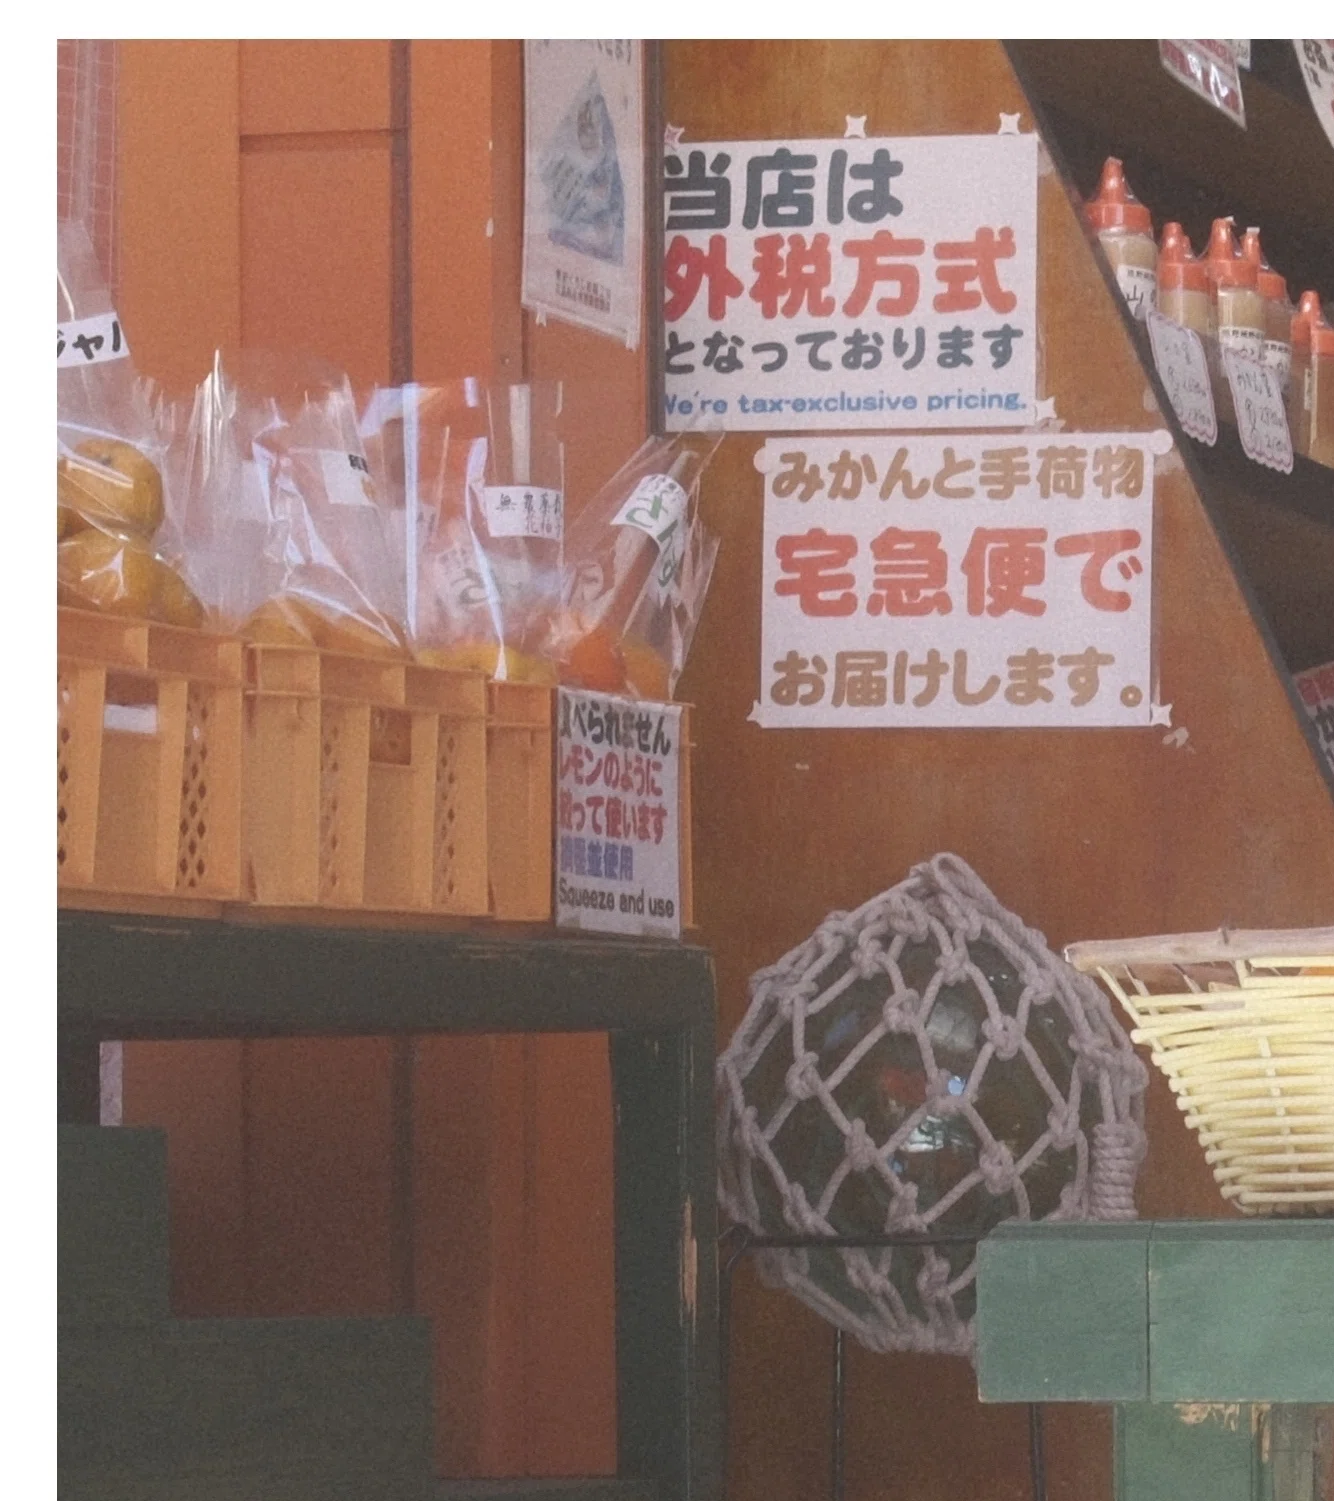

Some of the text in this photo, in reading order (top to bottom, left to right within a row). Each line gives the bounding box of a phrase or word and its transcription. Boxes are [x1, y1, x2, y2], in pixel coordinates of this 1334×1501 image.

[664, 148, 905, 231] 当店は
[664, 226, 1018, 322] 外税方式
[664, 323, 1025, 375] となっております
[926, 389, 1028, 416] pricing.
[770, 444, 1145, 503] みかんと手荷物
[773, 526, 1143, 618] 宅急便で
[770, 646, 1144, 708] お届けします。
[558, 875, 675, 919] Squeeze and use
